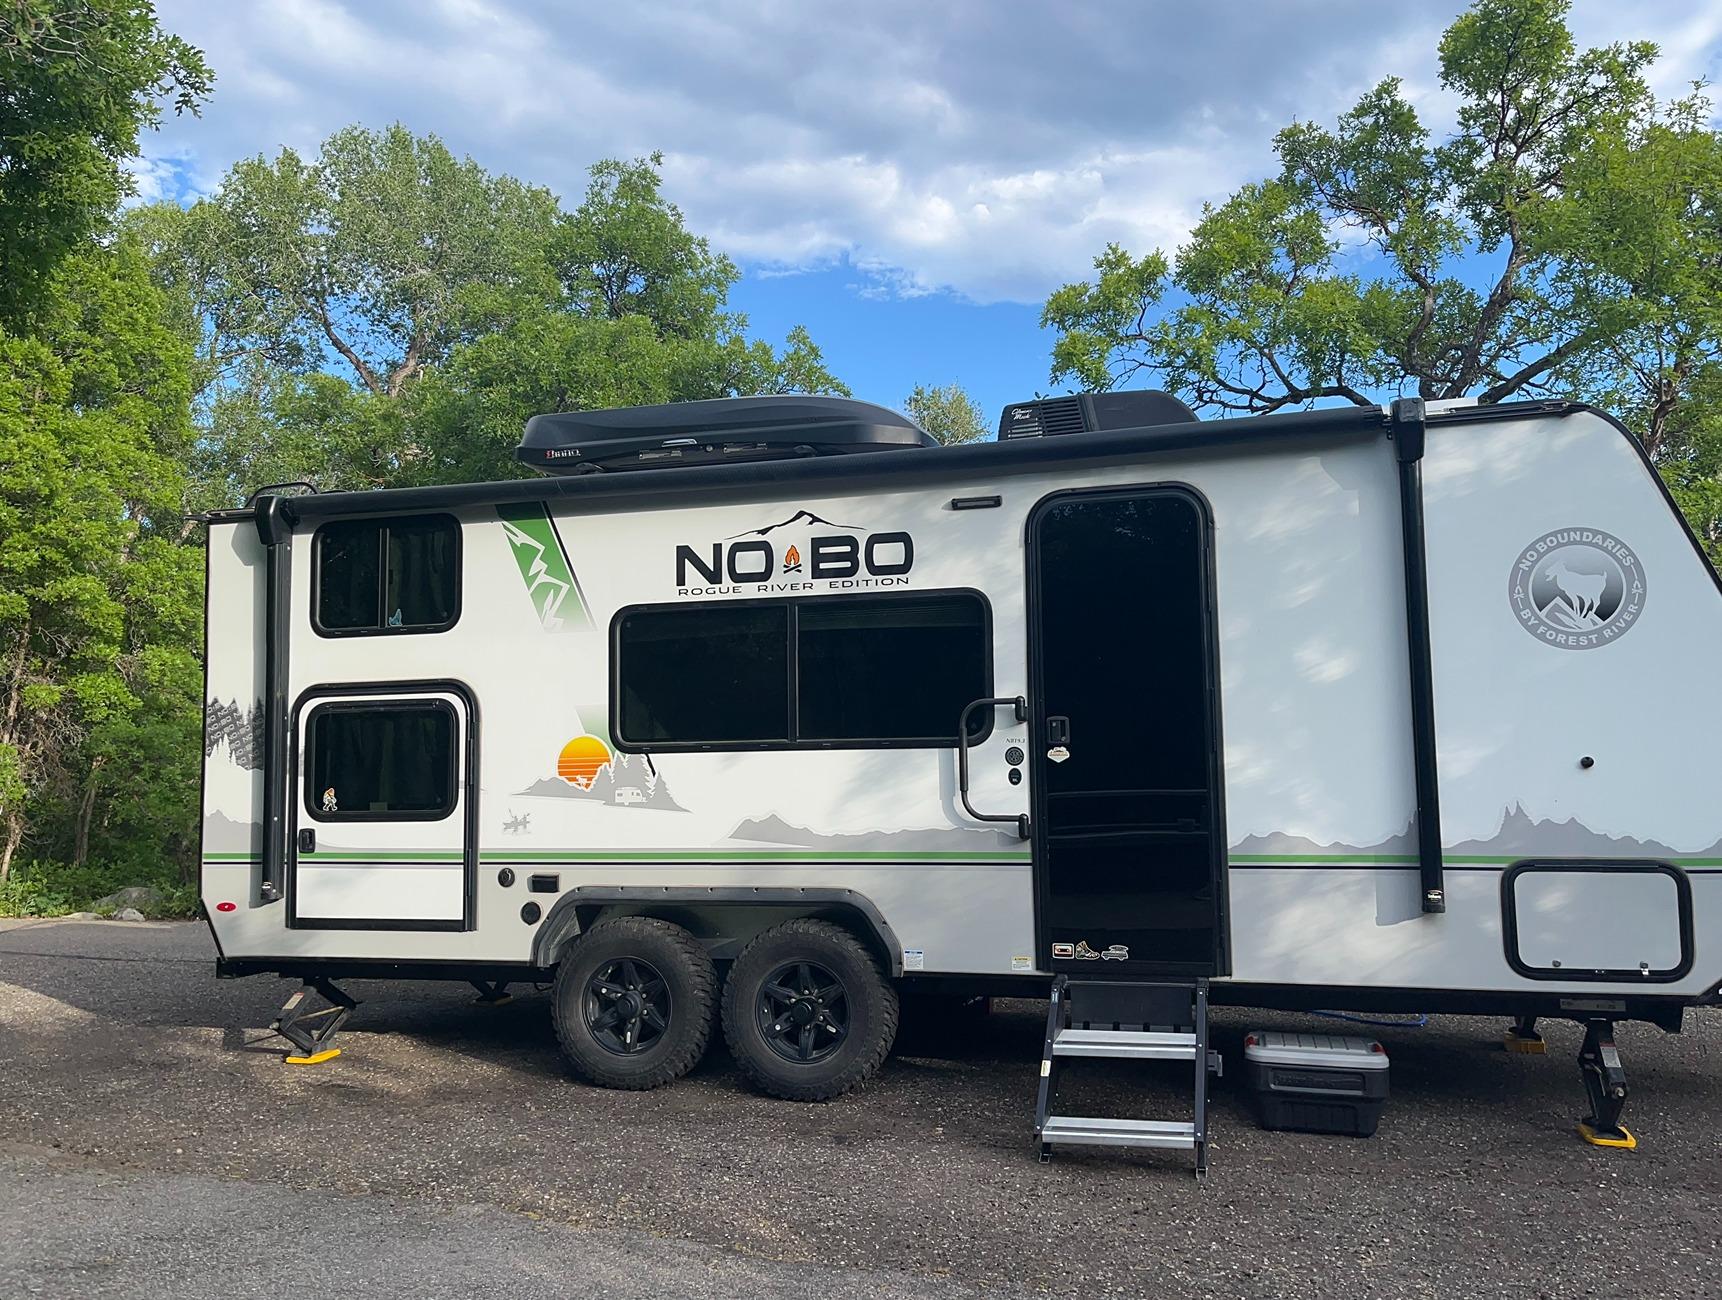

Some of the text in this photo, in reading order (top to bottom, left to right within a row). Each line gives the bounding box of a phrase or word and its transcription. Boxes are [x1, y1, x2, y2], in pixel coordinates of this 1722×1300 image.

[676, 531, 914, 587] NO BO
[1520, 531, 1634, 571] NO BOUNDARIES
[679, 577, 909, 596] ROGUE RIVER EDITION
[1520, 605, 1638, 646] BY FOREST RIVER
